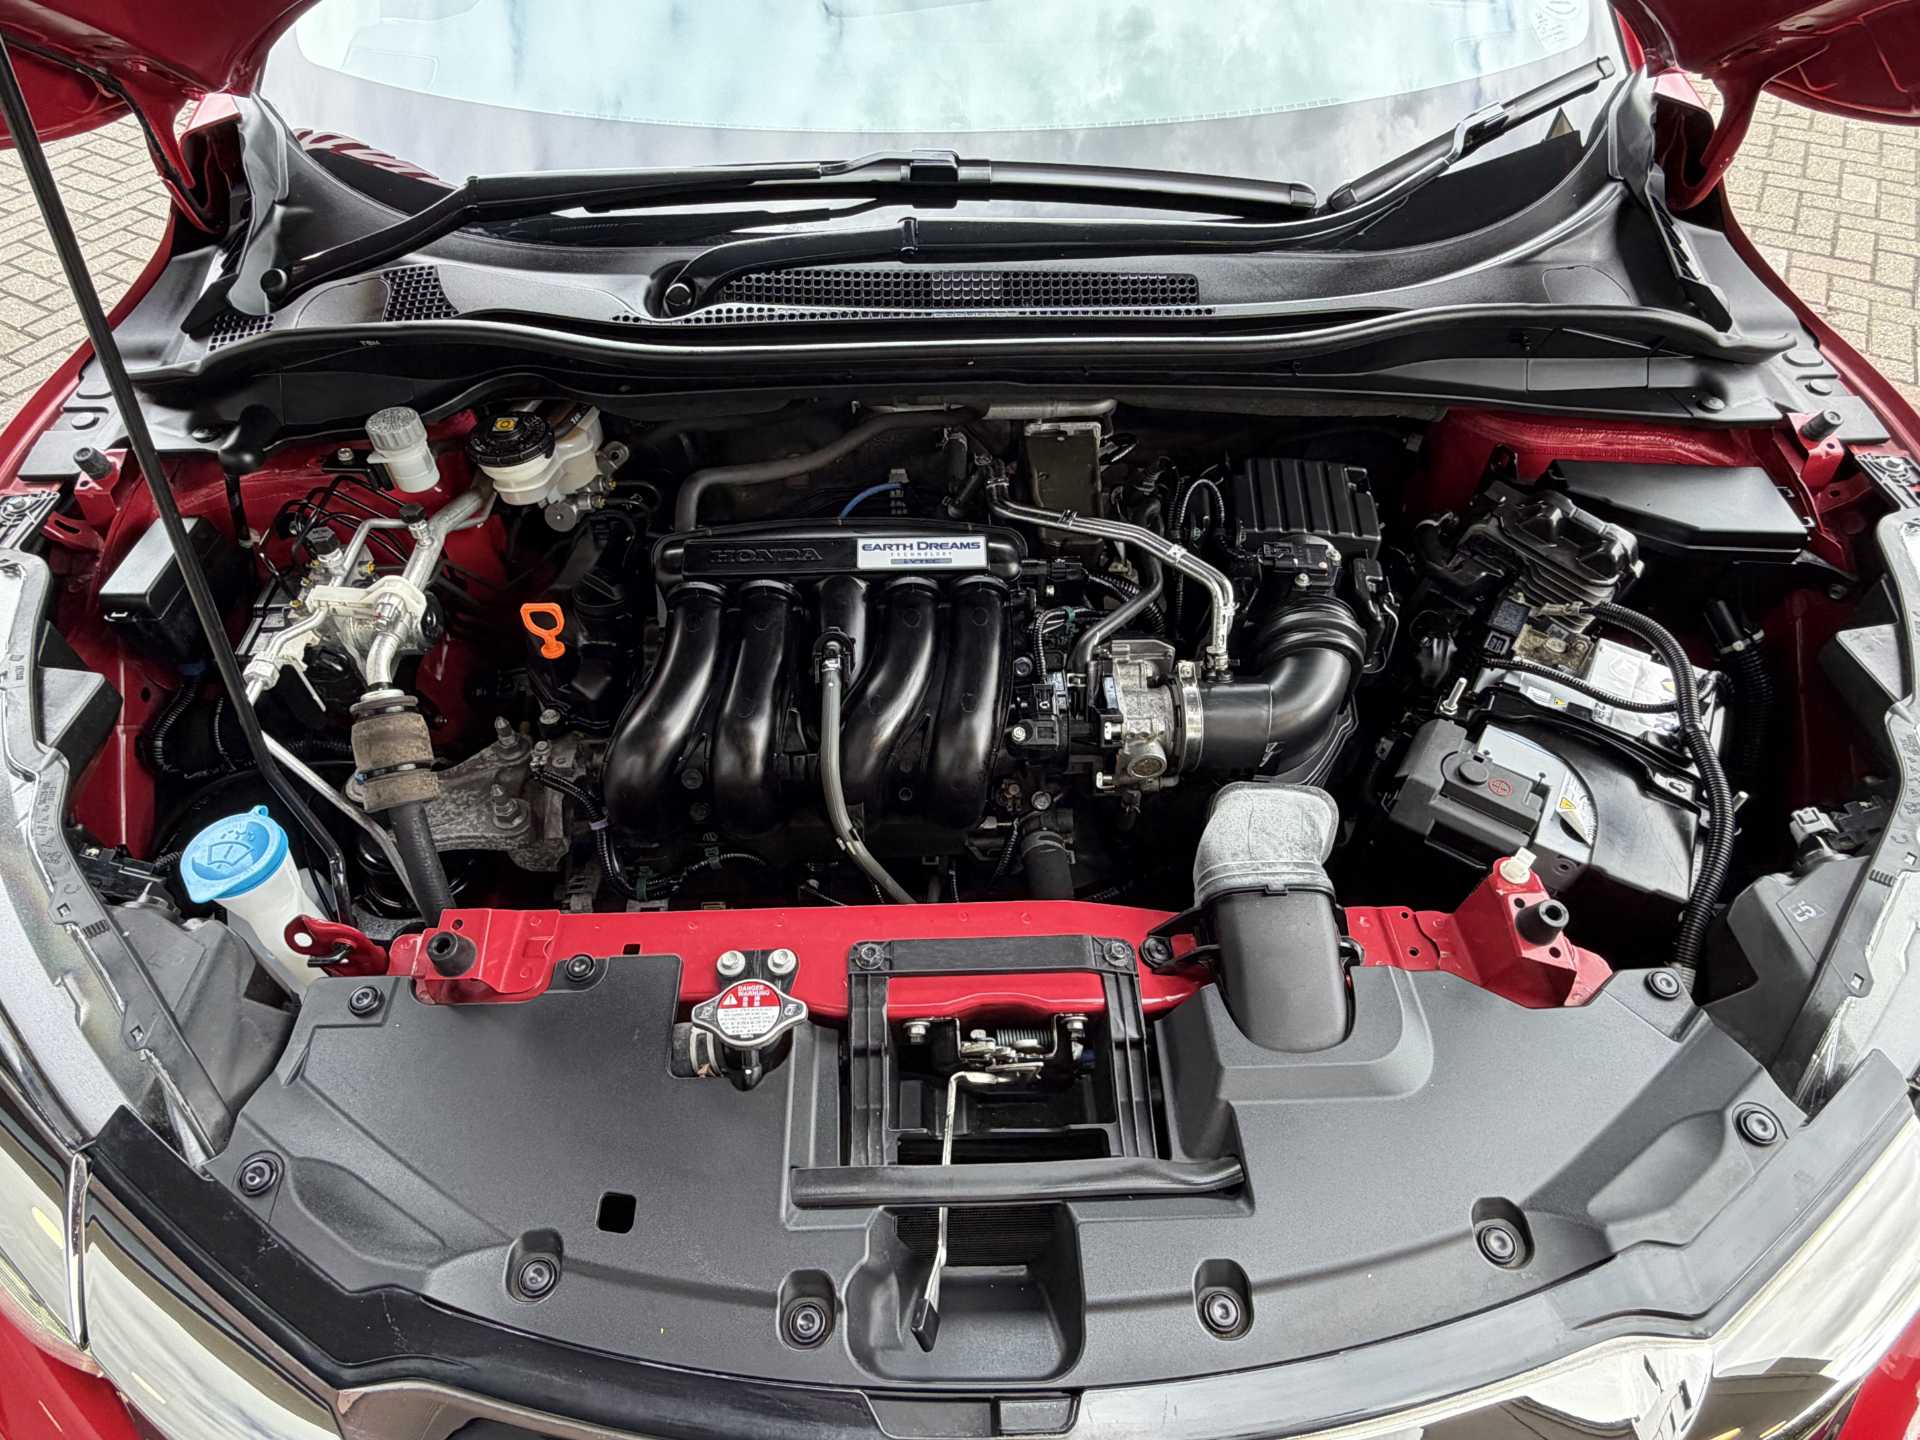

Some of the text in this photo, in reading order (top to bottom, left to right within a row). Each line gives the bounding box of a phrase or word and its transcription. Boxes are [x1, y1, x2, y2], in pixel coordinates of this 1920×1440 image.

[861, 541, 981, 552] EARTH DREAMS
[711, 547, 823, 562] HONDA
